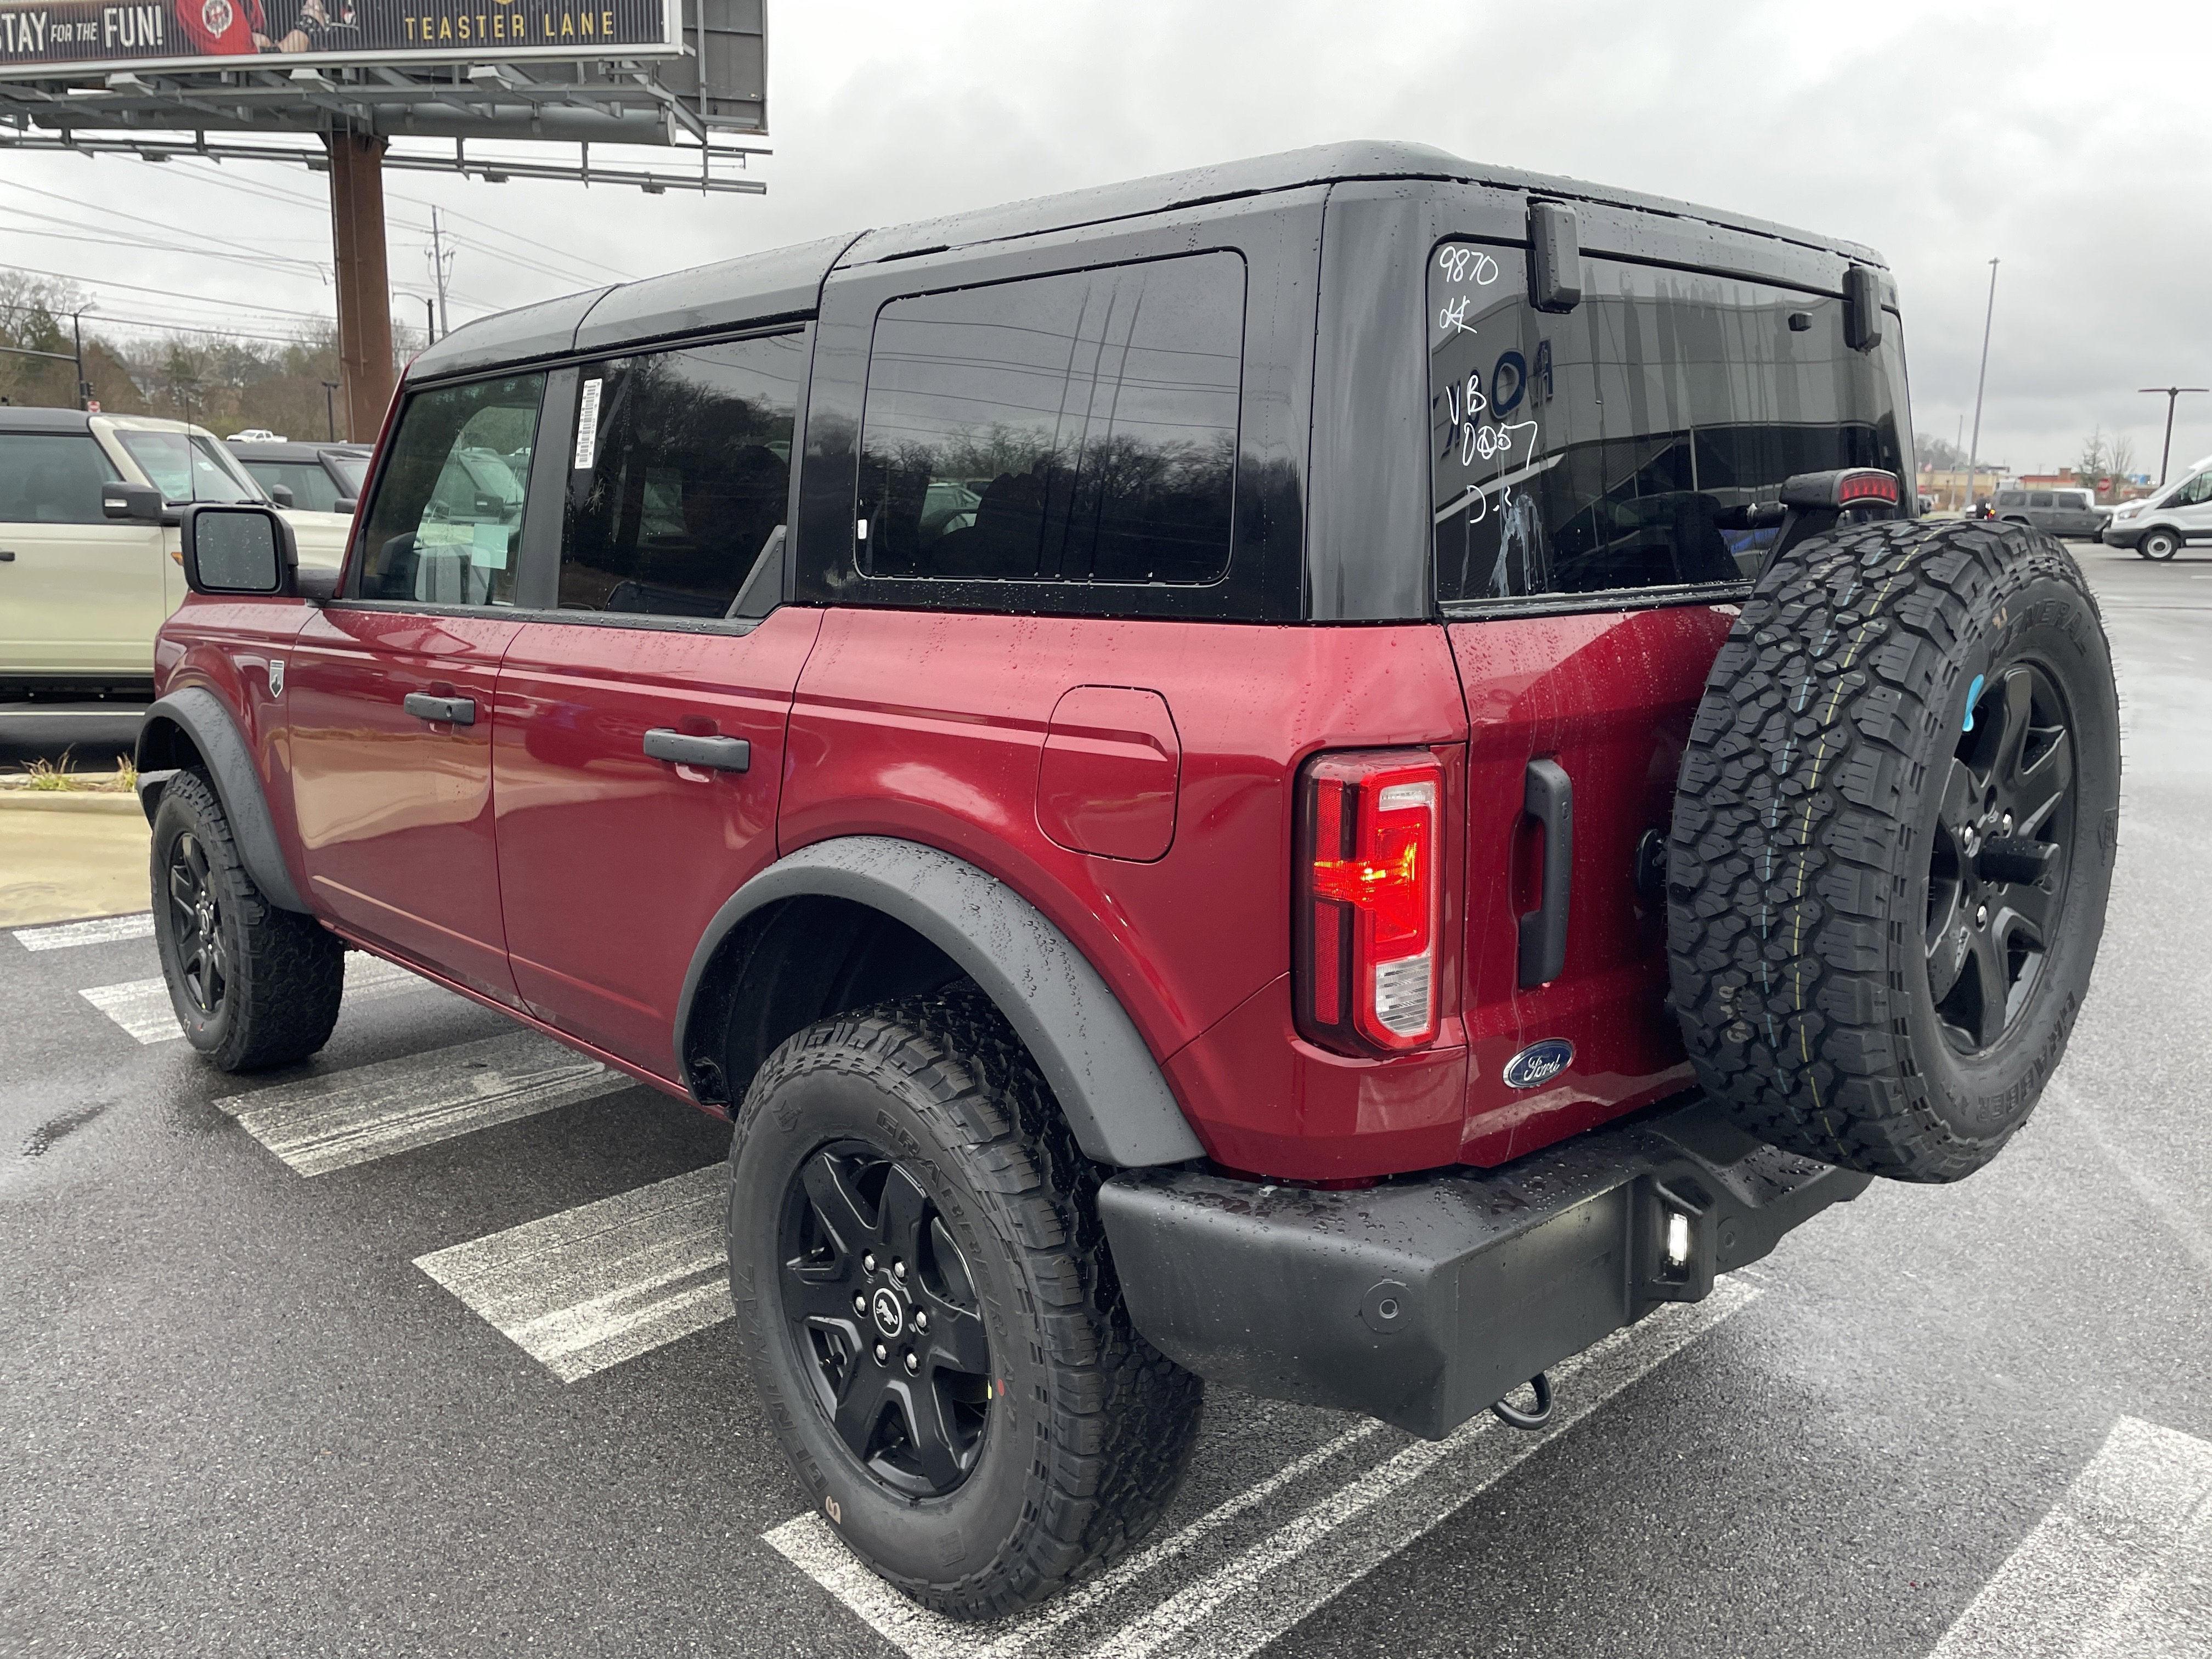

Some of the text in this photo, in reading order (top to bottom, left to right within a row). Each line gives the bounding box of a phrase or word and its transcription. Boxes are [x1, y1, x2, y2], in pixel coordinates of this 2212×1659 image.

[0, 5, 163, 53] TAY FOR THE FUN!
[405, 11, 614, 41] TEASTER LANE
[1439, 246, 1499, 285] 9870
[1523, 1053, 1561, 1081] Ford
